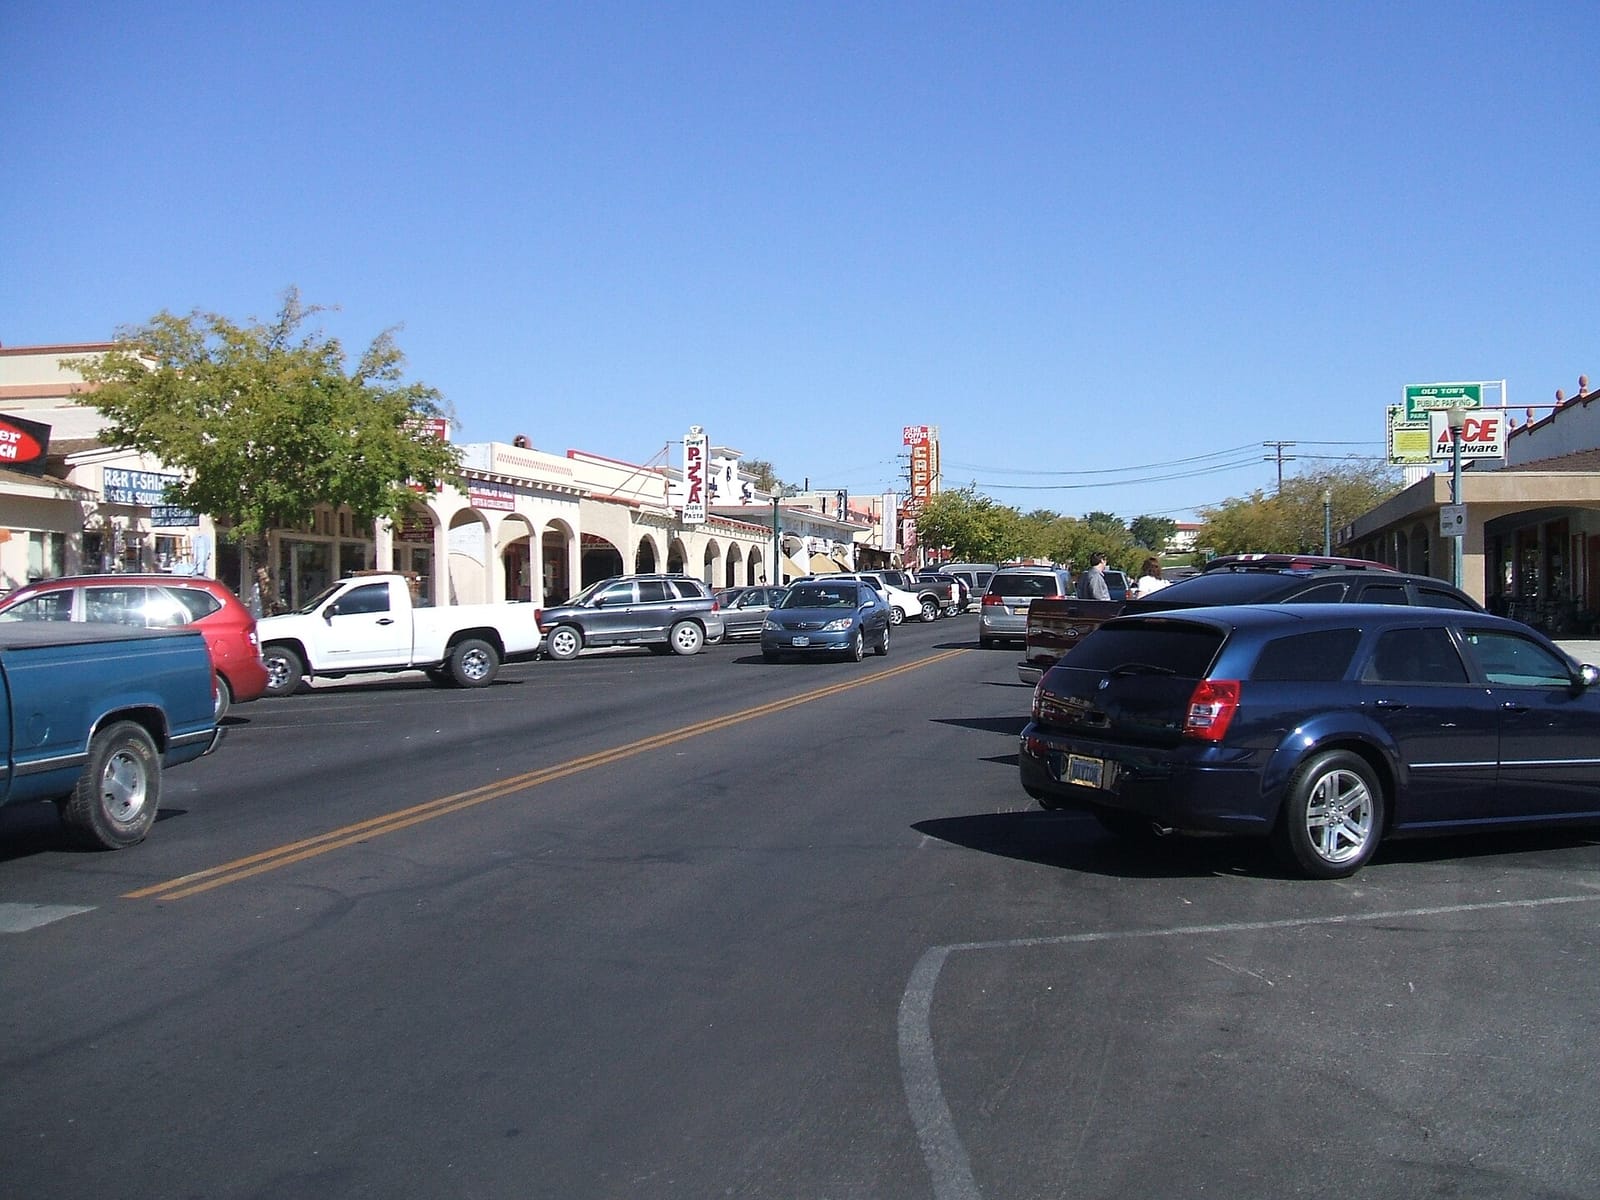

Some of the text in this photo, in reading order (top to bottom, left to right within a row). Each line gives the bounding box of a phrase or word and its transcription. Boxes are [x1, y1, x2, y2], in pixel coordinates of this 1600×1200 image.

[1416, 398, 1471, 408] PUBLIC PARKING
[1436, 444, 1498, 454] Hadware
[104, 469, 129, 488] R&R
[684, 512, 704, 520] PASTA
